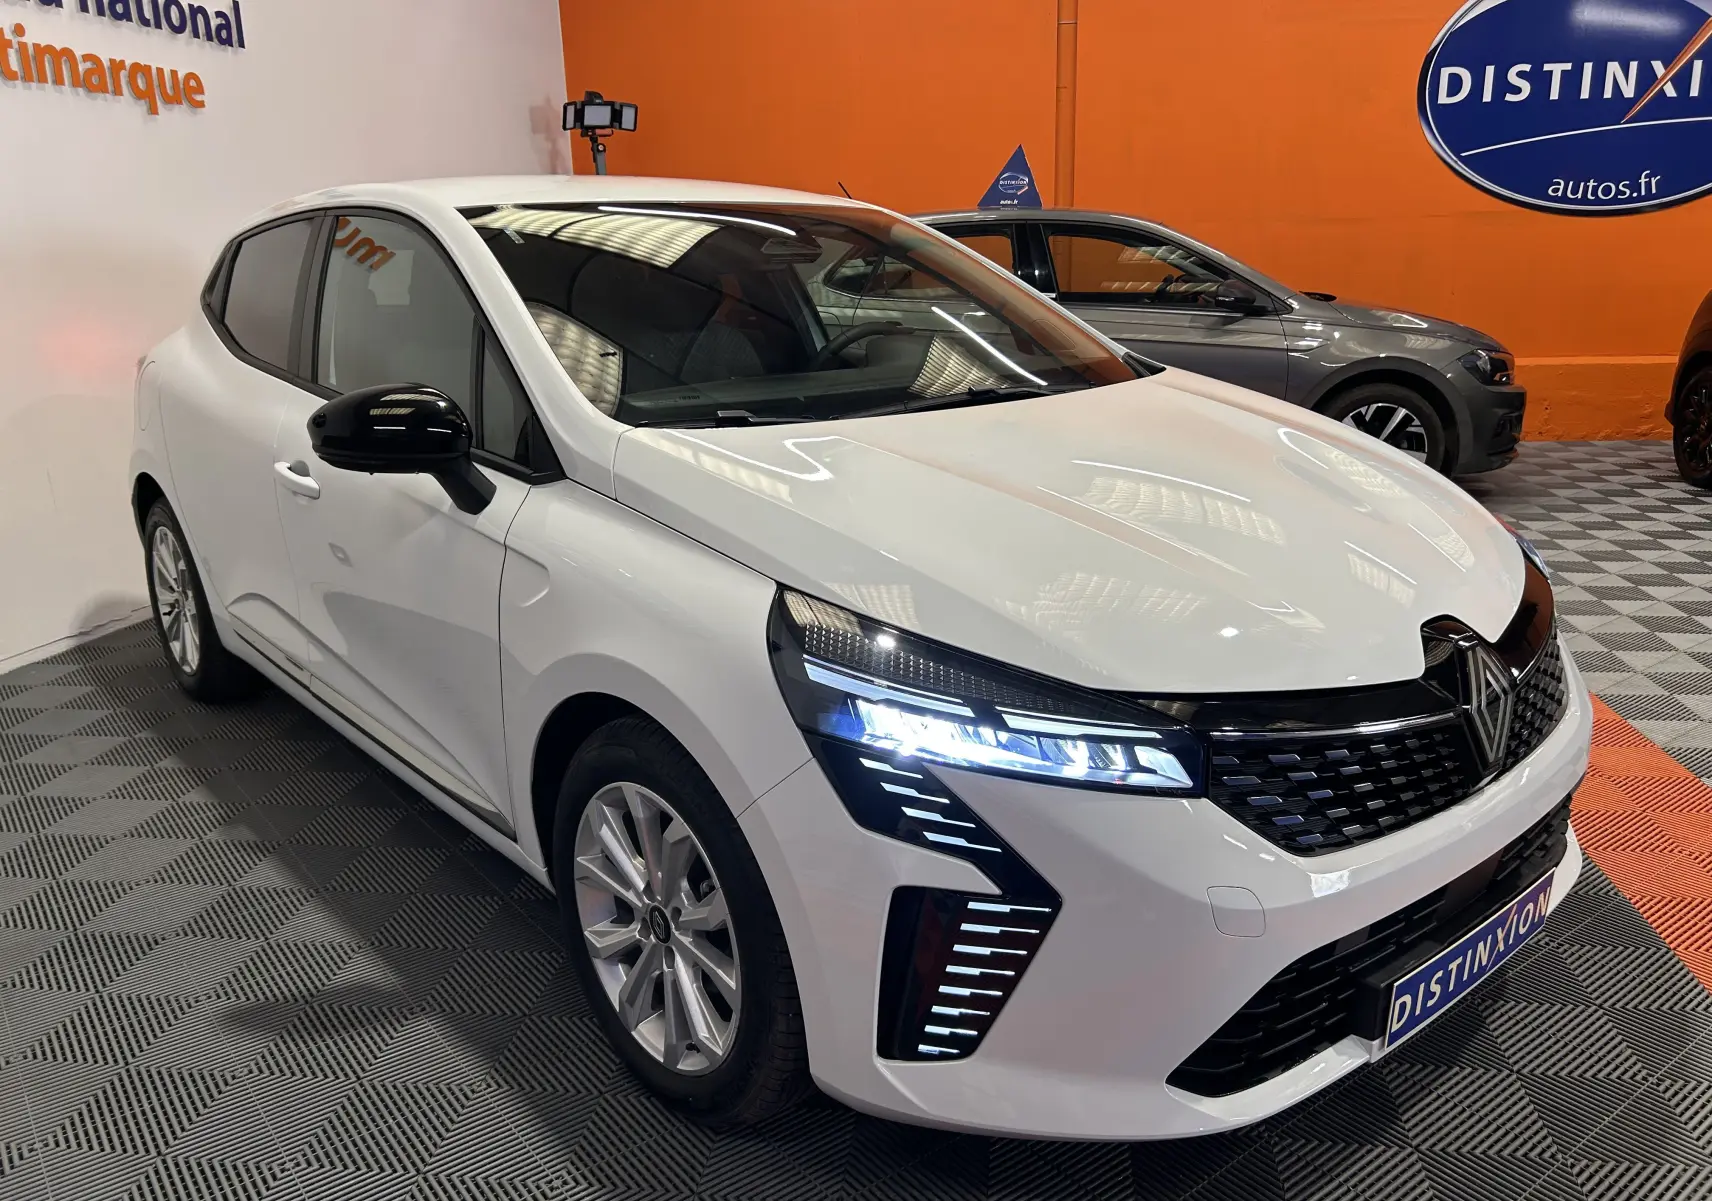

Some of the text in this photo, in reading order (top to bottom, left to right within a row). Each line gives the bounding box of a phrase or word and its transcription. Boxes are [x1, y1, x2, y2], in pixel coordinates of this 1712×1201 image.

[0, 23, 206, 115] timarque
[1547, 170, 1661, 200] autos.fr
[1390, 887, 1551, 1034] DISTINXION
